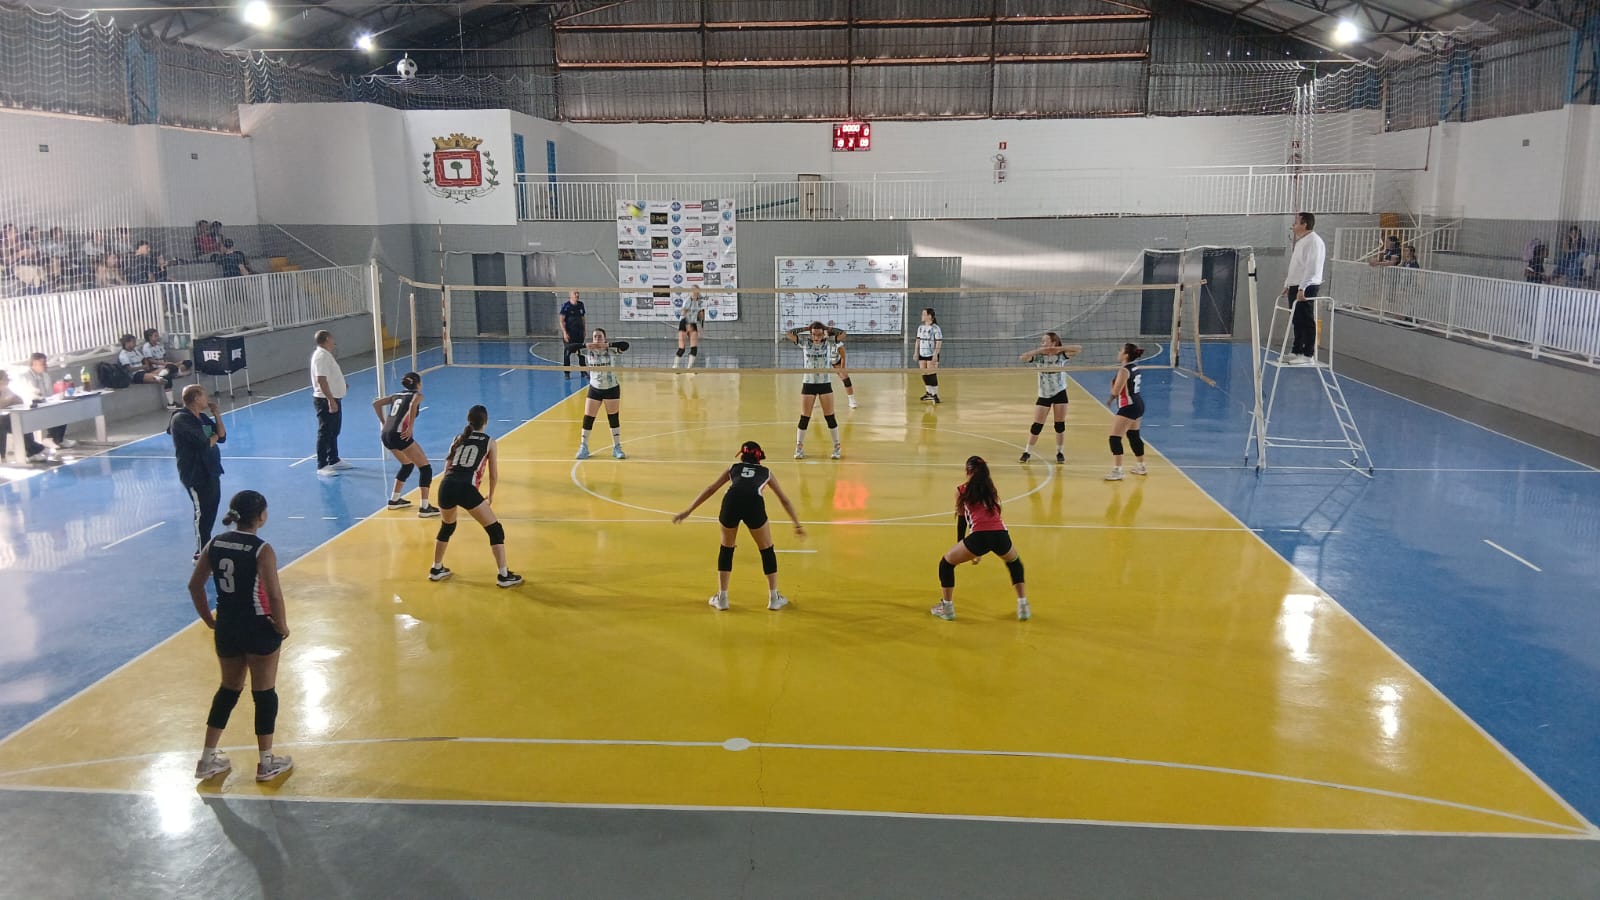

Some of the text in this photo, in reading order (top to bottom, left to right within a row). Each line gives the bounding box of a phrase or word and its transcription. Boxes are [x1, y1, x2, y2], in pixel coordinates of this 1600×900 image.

[390, 399, 402, 417] 6
[452, 445, 479, 467] 10
[741, 467, 756, 478] 5
[219, 558, 235, 593] 3
